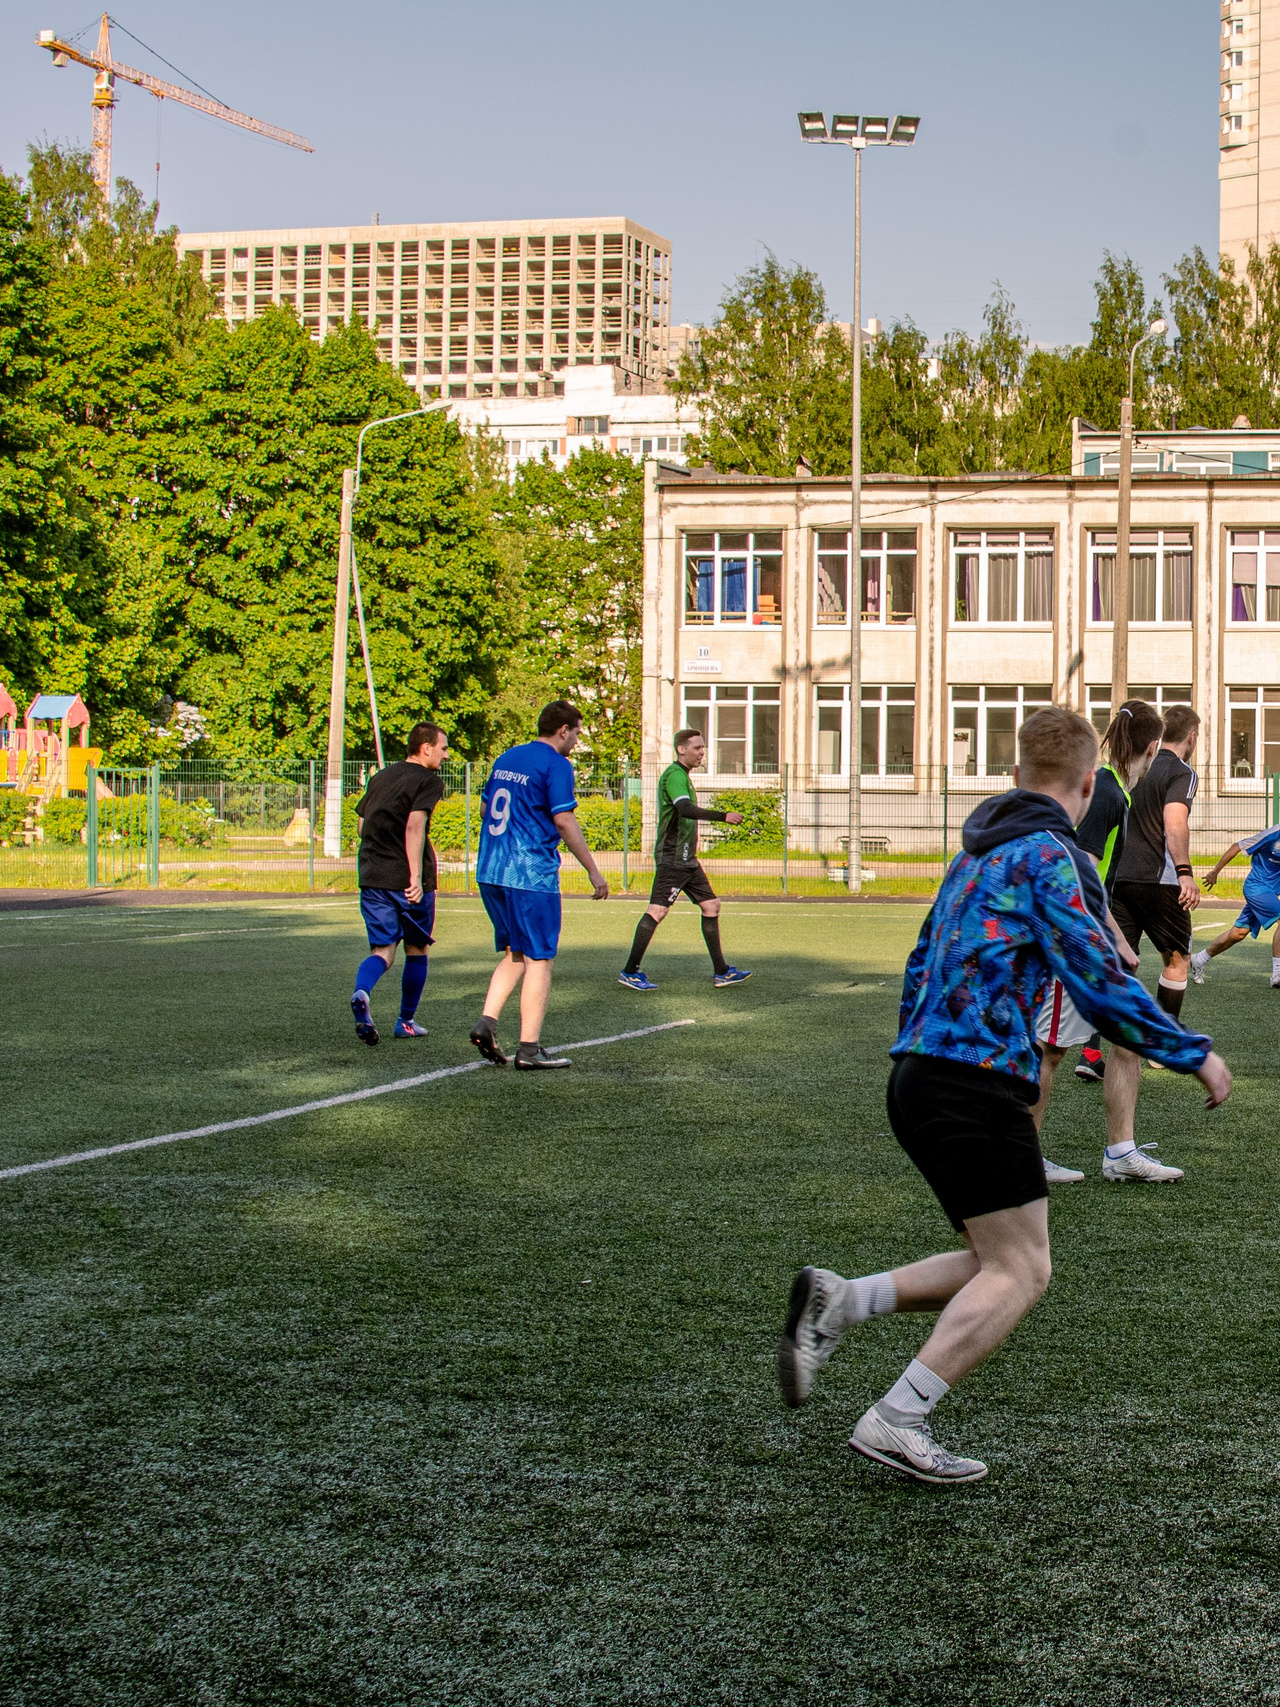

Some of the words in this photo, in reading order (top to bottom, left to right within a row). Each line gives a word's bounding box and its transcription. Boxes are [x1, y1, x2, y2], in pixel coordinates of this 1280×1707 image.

[698, 648, 709, 657] 10
[493, 769, 529, 786] ЯКОВЧУК
[488, 787, 511, 836] 9
